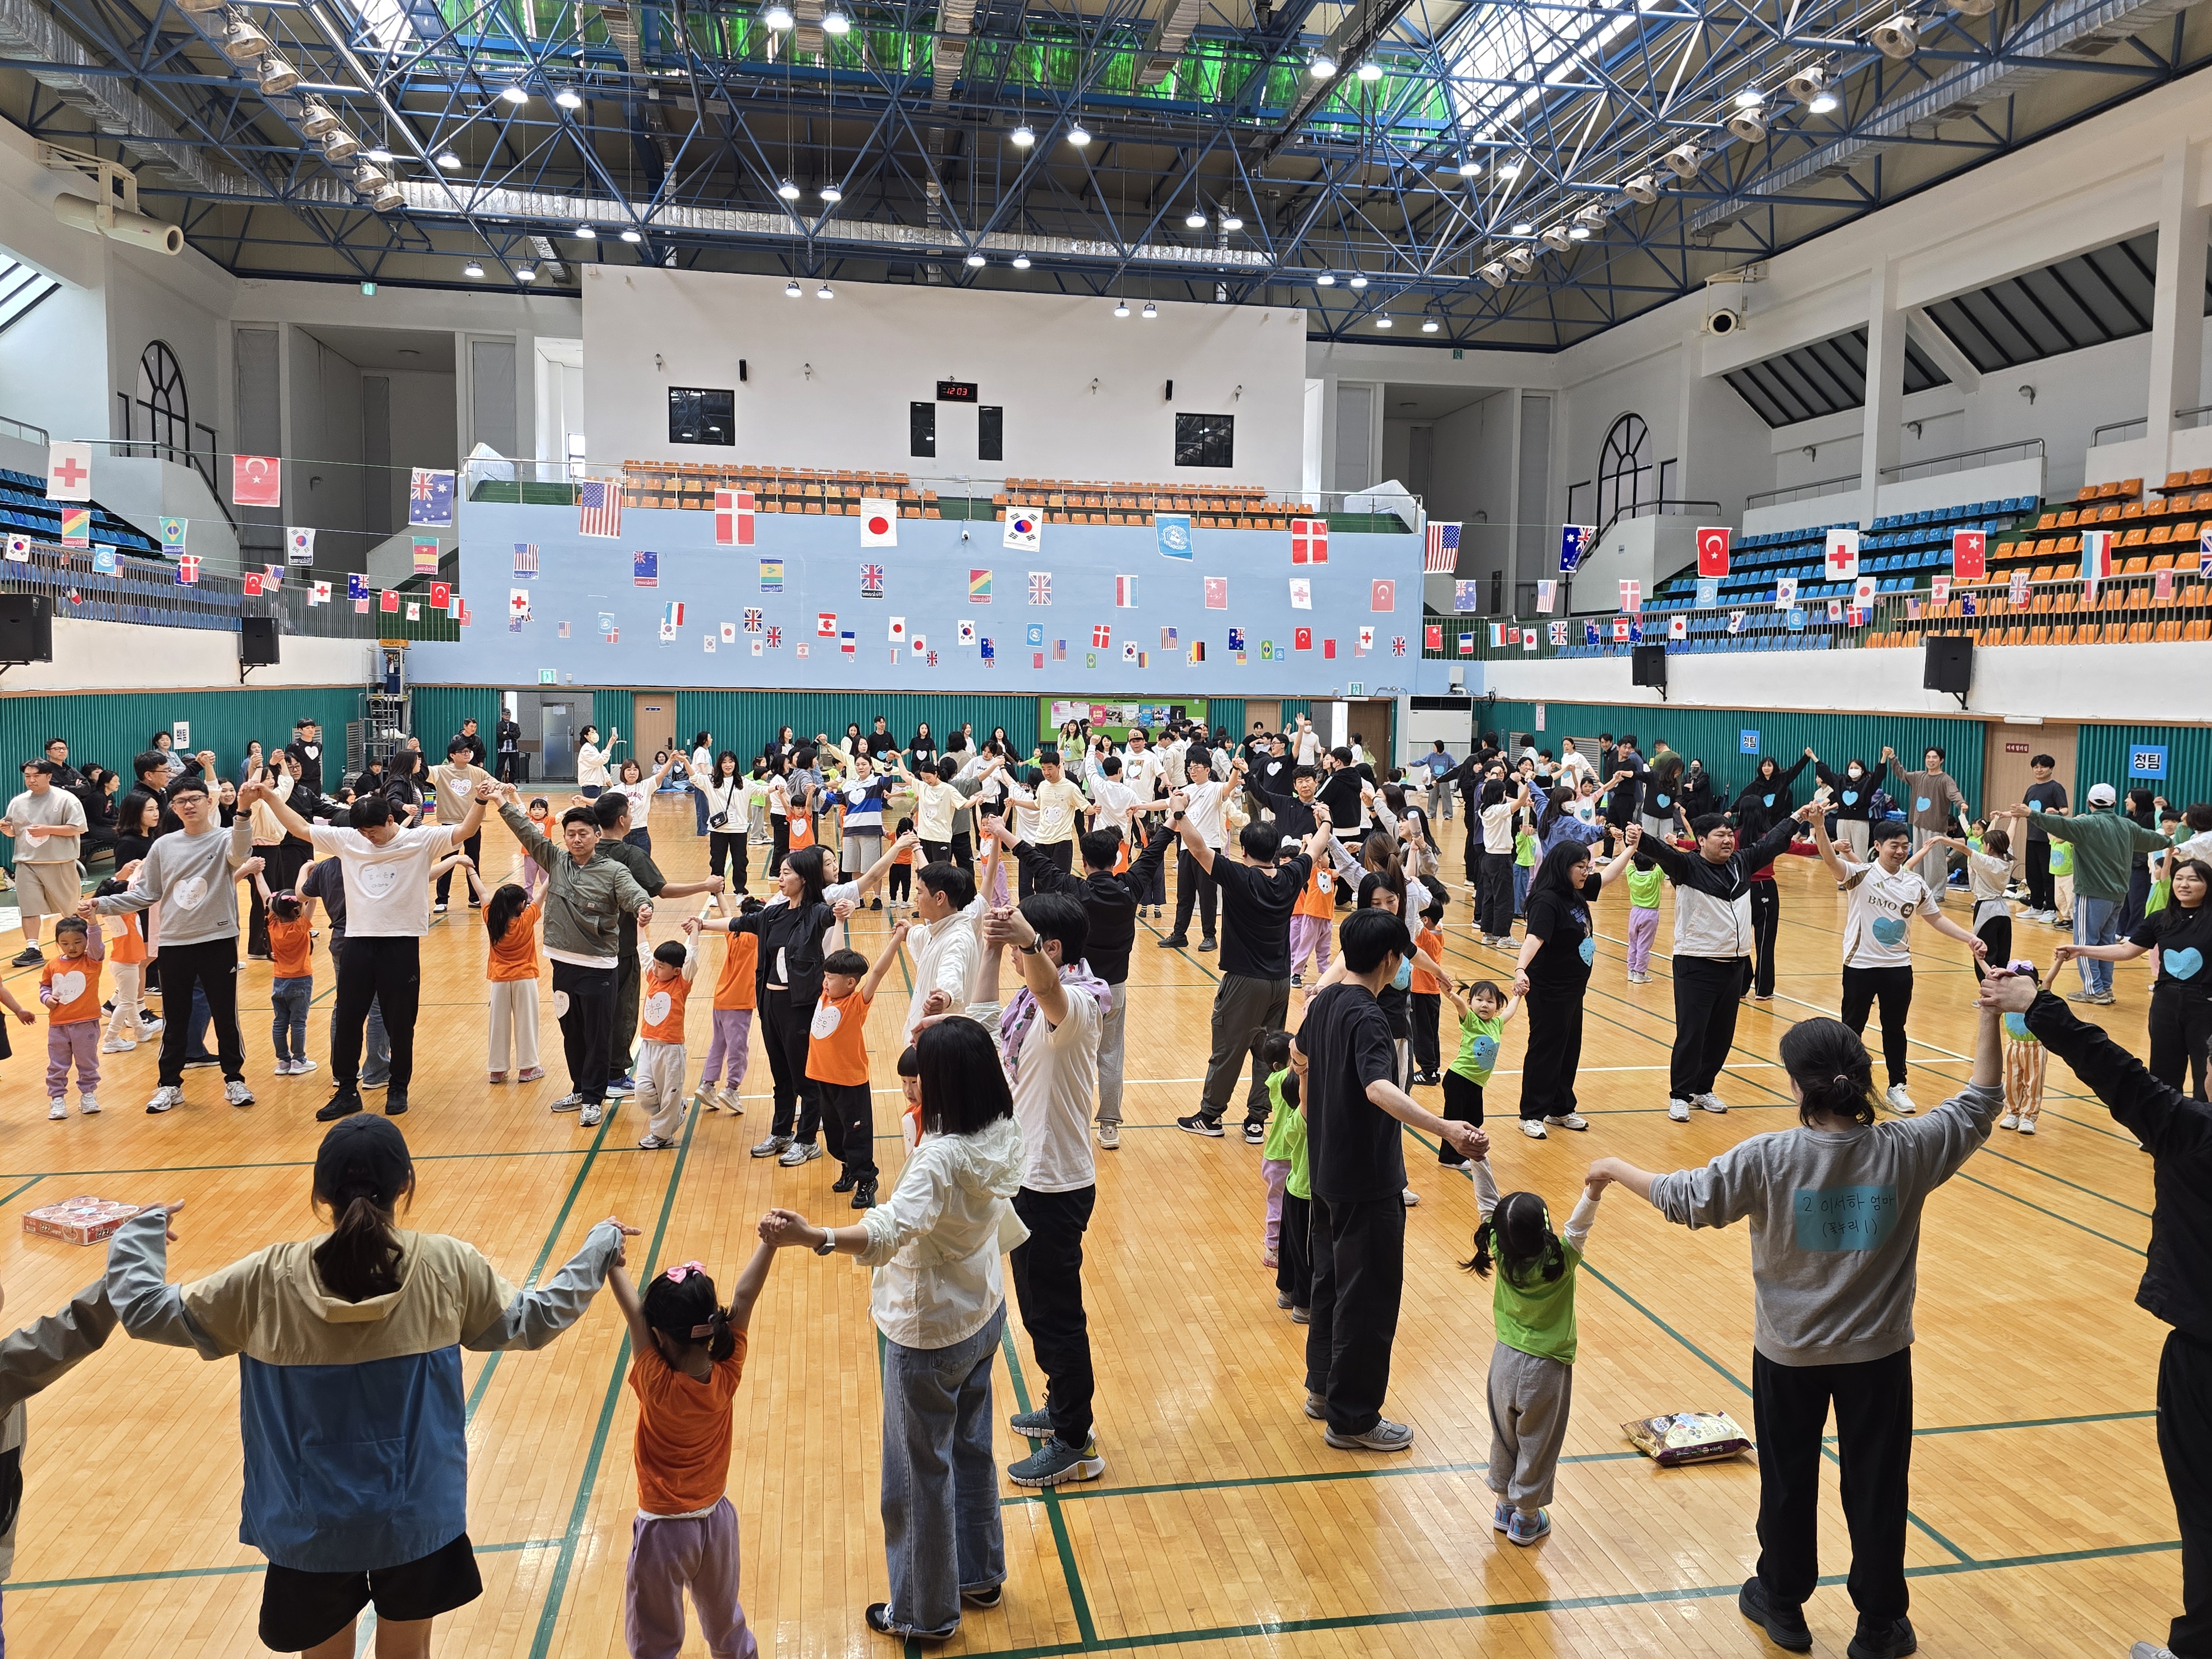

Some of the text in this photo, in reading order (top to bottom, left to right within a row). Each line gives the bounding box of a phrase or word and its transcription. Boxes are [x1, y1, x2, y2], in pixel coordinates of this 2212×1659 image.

[1743, 736, 1756, 748] 청팀
[2134, 753, 2161, 770] 청팀
[1867, 895, 1897, 911] BMO
[1820, 1193, 1865, 1214] 이서하
[1870, 1194, 1895, 1211] 엄마
[40, 1222, 51, 1233] 김치
[96, 1227, 111, 1239] 김치
